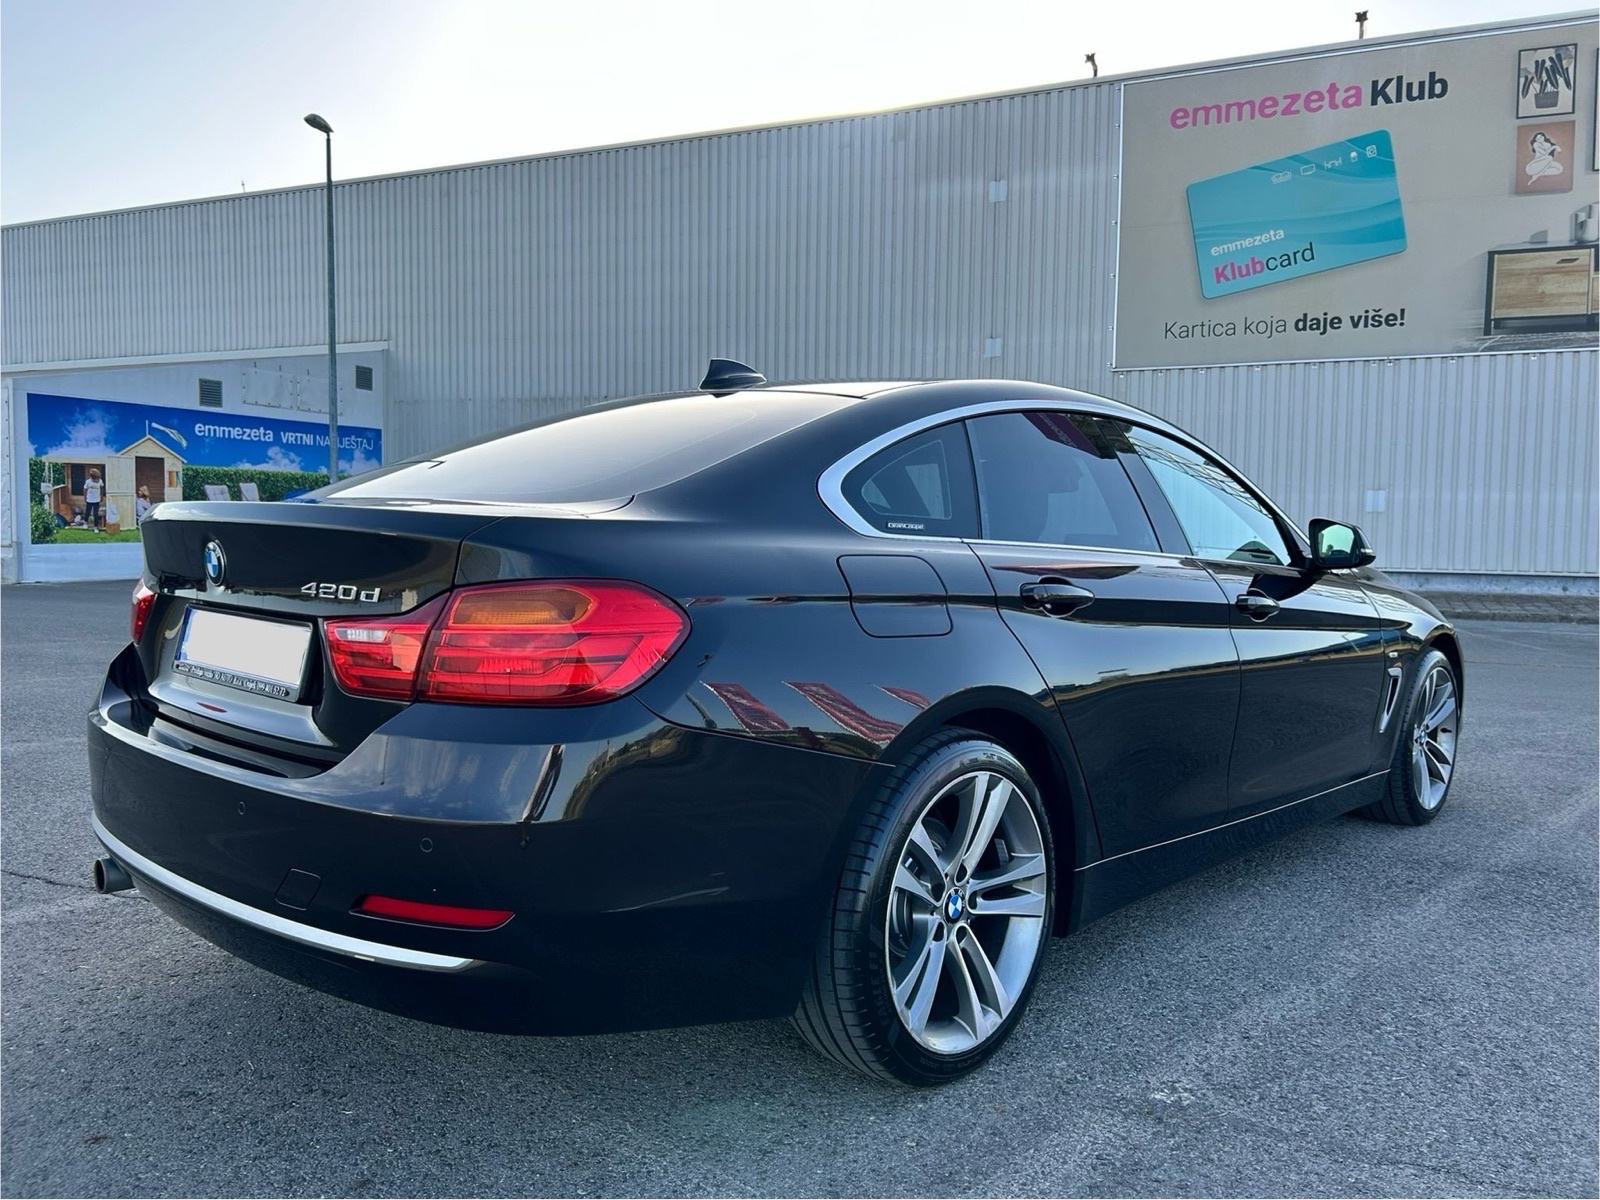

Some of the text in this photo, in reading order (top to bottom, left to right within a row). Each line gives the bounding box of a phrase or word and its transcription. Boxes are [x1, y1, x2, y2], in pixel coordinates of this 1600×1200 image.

[1169, 72, 1448, 129] emmezeta Klub
[1210, 227, 1285, 256] emmezeta
[1214, 242, 1315, 284] Klubcard
[1164, 309, 1405, 340] Kartica koja daje više!
[194, 422, 374, 451] emmezeta VRTNI NAJEŠTAJ
[301, 582, 381, 604] 420d
